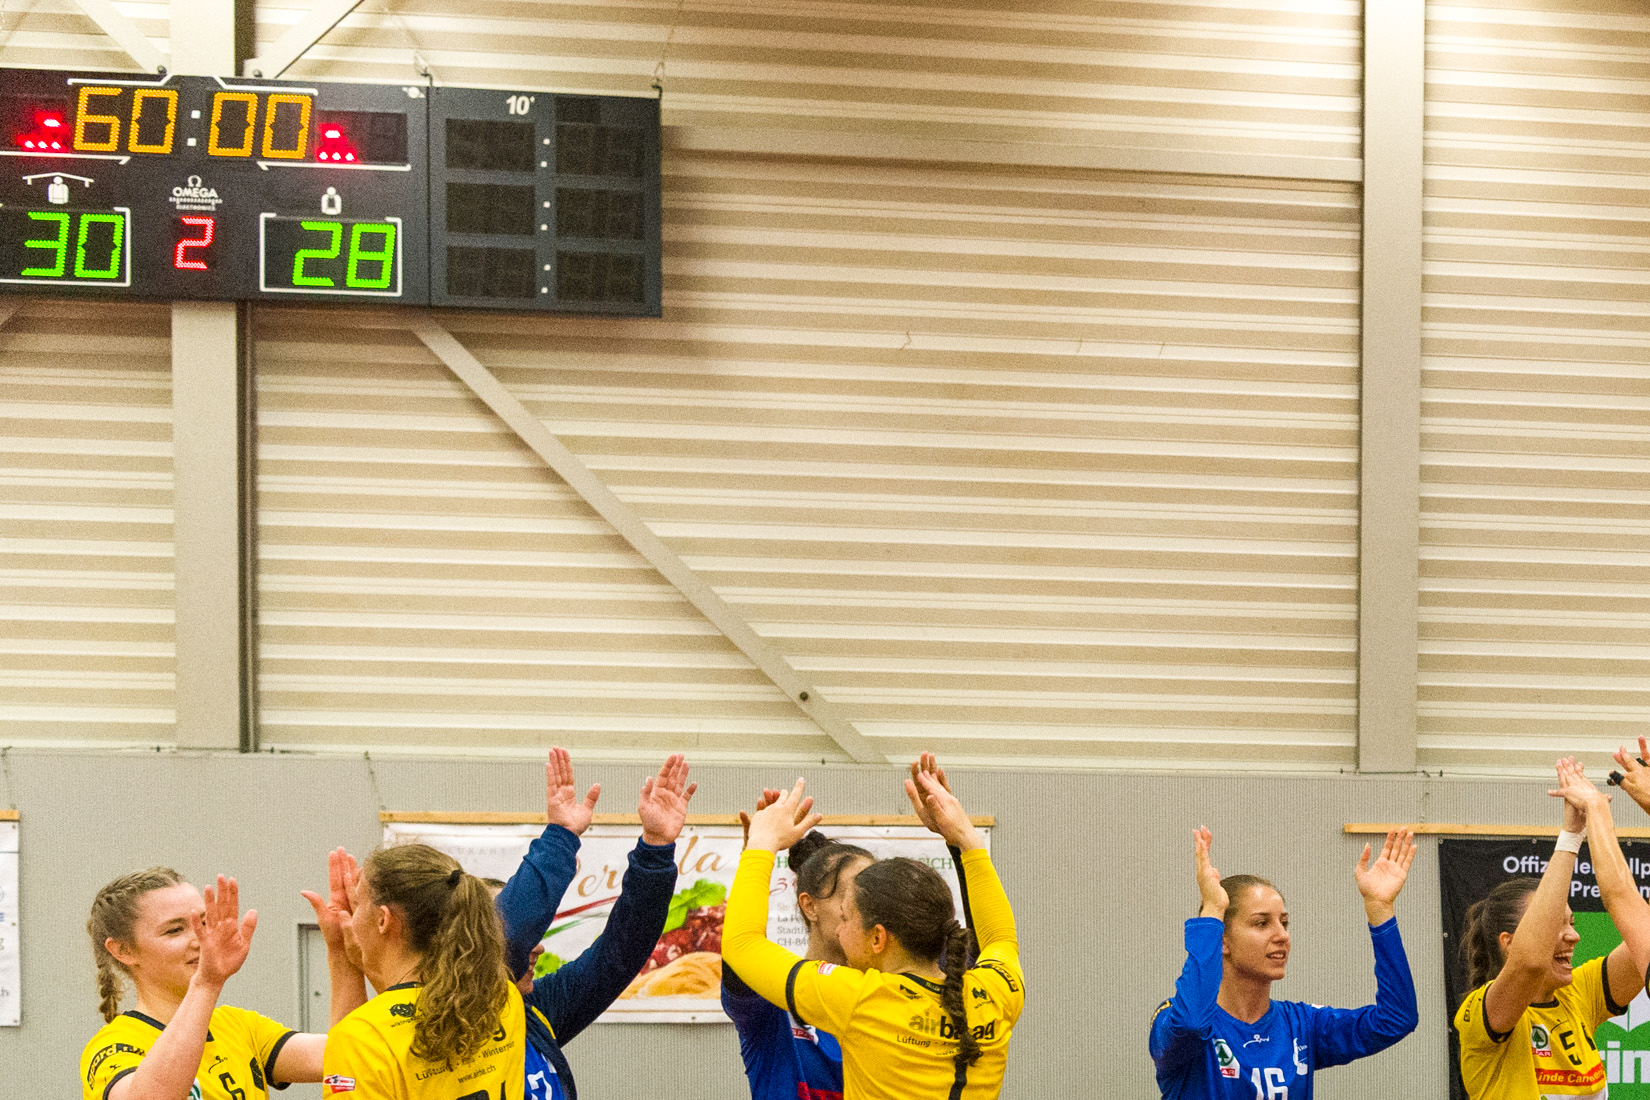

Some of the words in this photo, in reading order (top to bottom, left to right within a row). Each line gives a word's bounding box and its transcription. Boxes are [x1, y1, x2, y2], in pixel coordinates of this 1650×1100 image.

[73, 86, 312, 159] 60:00
[172, 186, 219, 199] OMEGA
[21, 211, 124, 278] 30
[174, 216, 214, 270] 2
[292, 221, 396, 288] 28
